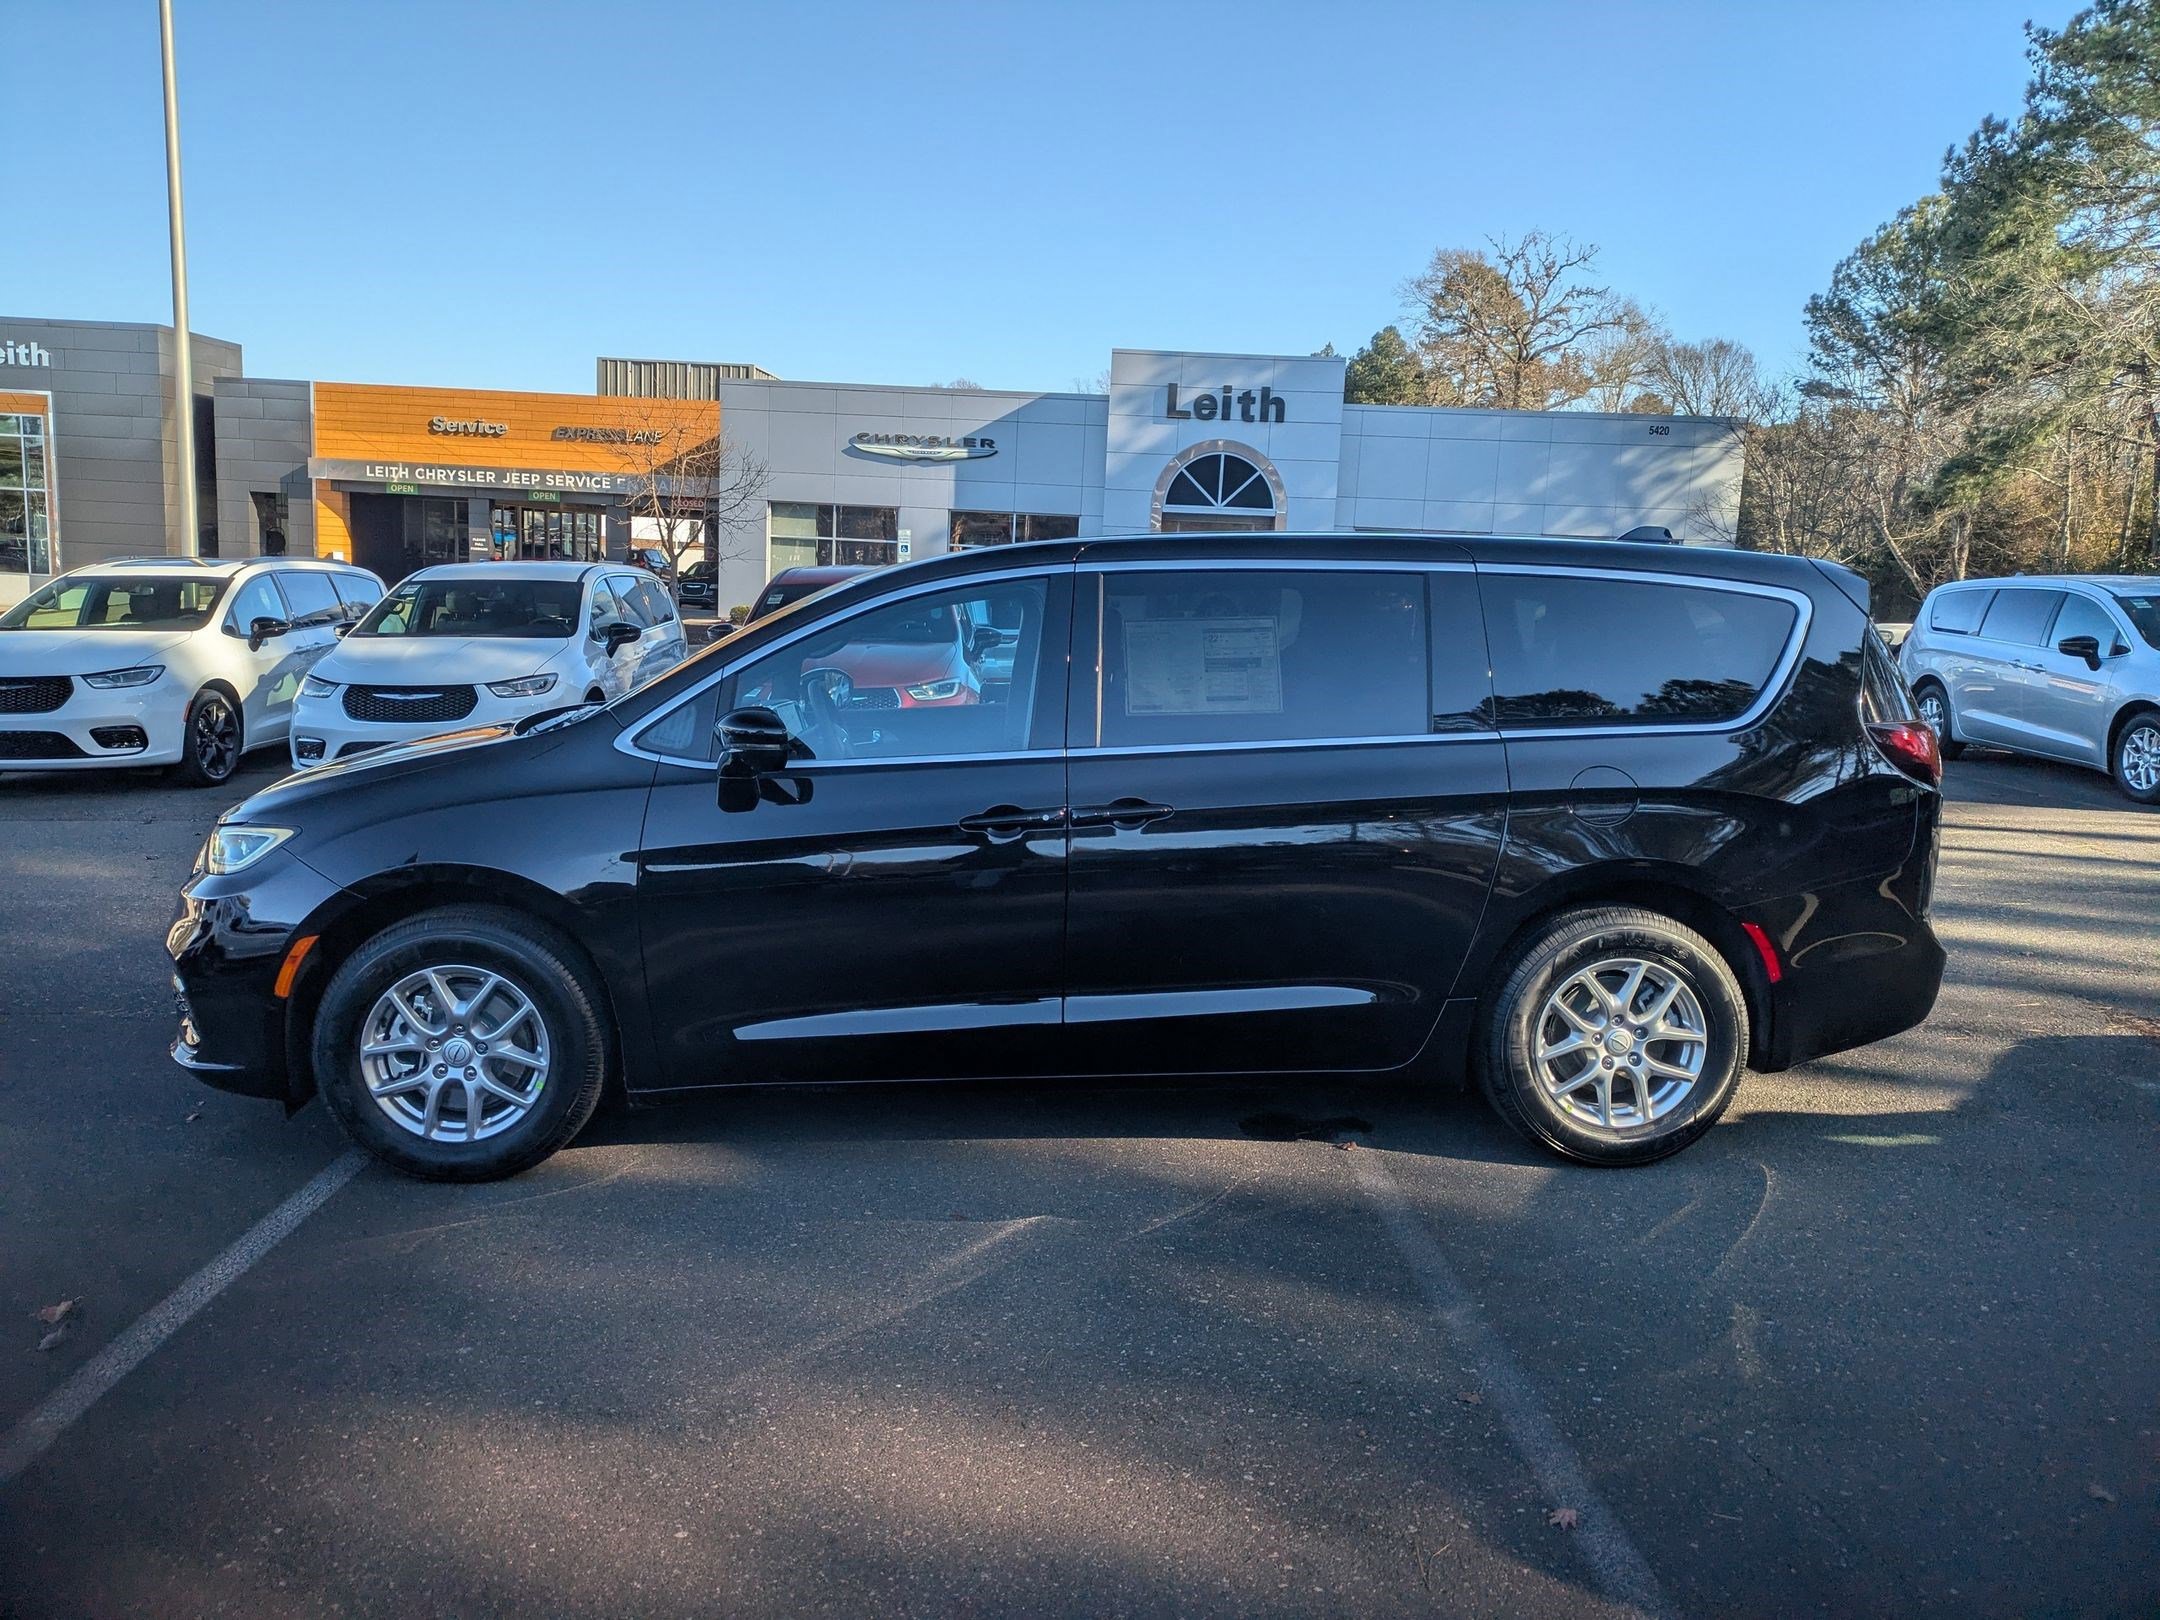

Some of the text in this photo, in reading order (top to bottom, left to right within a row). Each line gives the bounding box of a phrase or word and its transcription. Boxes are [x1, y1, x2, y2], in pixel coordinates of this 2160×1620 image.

[1167, 383, 1286, 423] Leith
[432, 416, 509, 435] Service
[1649, 425, 1670, 436] 5420
[626, 430, 663, 443] LANE
[856, 432, 996, 449] CHRYSLER
[366, 465, 409, 479] LEITH
[415, 468, 495, 483] CHRYSLER
[502, 472, 540, 485] JEEP
[545, 474, 611, 489] SERVICE
[391, 484, 414, 493] OPEN
[532, 491, 556, 500] OPEN
